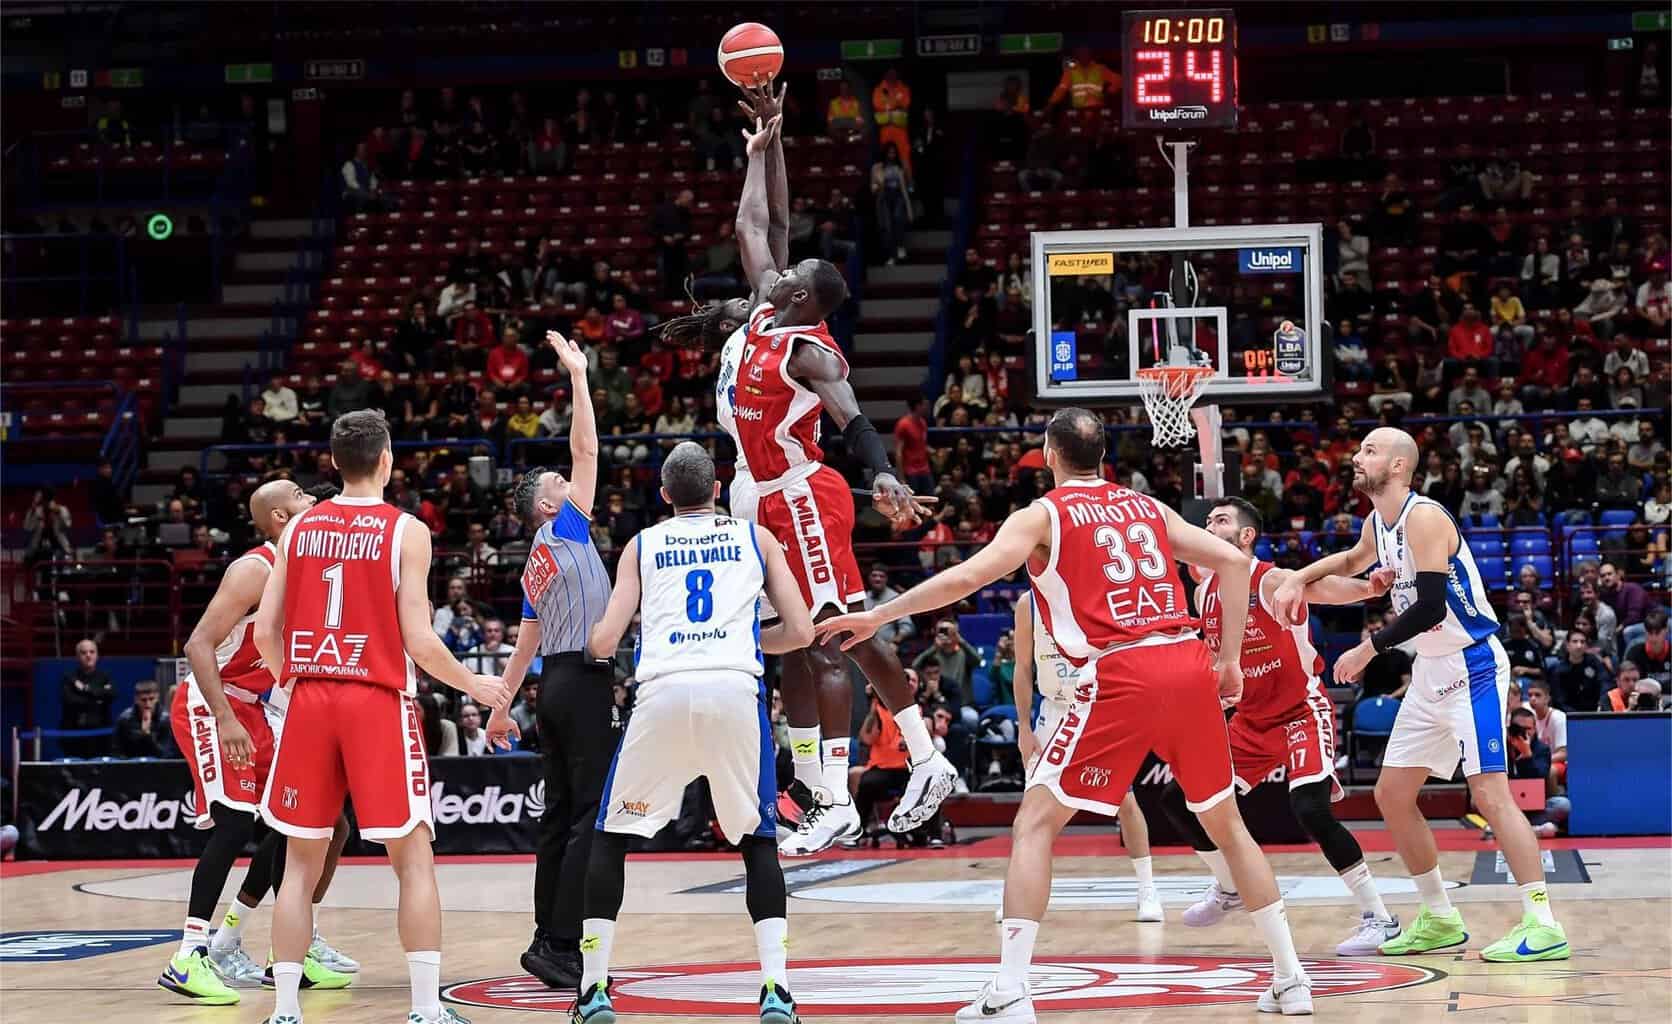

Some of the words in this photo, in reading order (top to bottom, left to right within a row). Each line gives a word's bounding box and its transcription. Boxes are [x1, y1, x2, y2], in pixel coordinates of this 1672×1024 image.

[1144, 18, 1223, 43] 10:00
[1137, 50, 1221, 103] 24
[1150, 107, 1207, 122] UnipolForum
[1250, 251, 1292, 269] Unipol
[1279, 343, 1302, 352] LBA
[1054, 363, 1075, 371] FIP
[349, 514, 387, 530] AON
[792, 496, 830, 584] MILANO
[655, 549, 698, 570] DELLA
[700, 545, 742, 563] VALLE
[1094, 522, 1167, 584] 33
[322, 562, 344, 629] 1
[686, 569, 713, 623] 8
[1106, 583, 1174, 620] EA7
[291, 631, 369, 666] EA7
[192, 704, 217, 783] OLIMPA
[403, 695, 427, 797] OLIMPI
[1290, 747, 1306, 770] 17
[37, 788, 179, 831] Media
